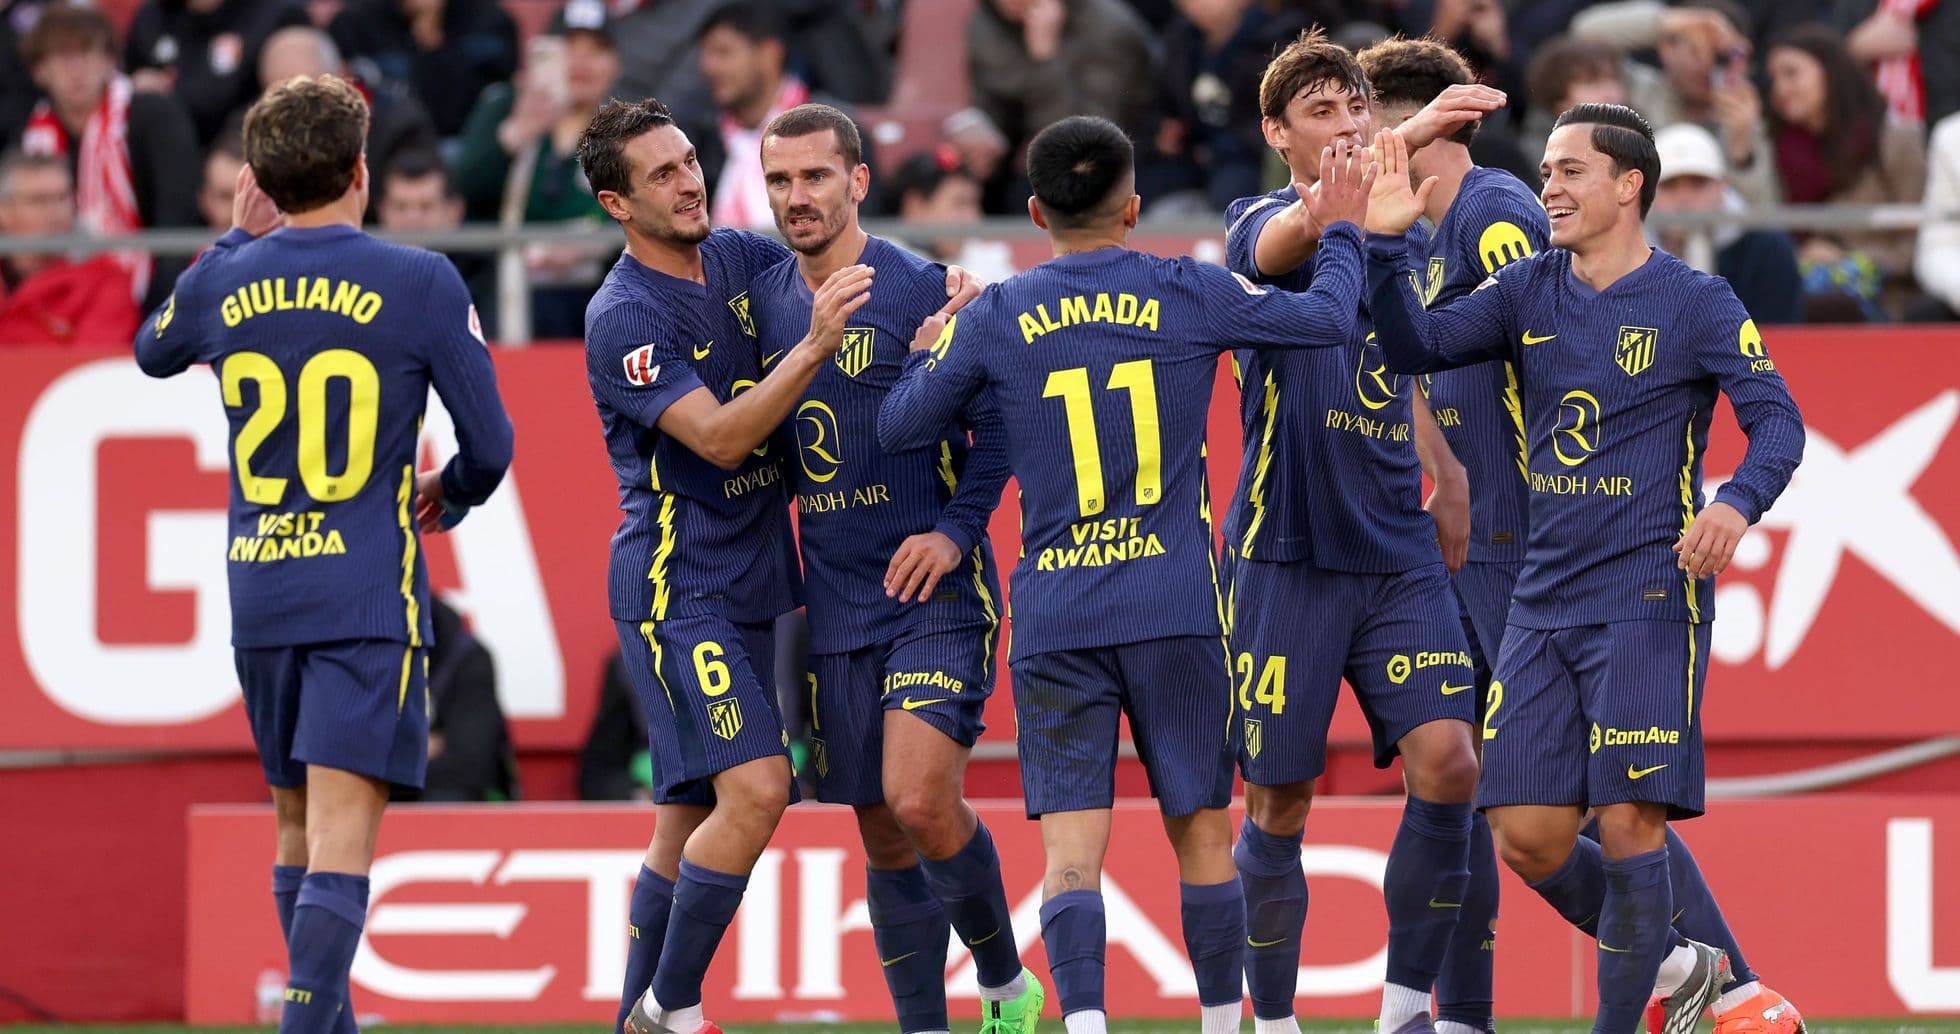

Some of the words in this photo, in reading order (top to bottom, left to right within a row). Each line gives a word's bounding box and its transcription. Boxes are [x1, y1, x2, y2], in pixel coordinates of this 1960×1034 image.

[220, 276, 383, 328] GIULIANO
[1017, 293, 1160, 345] ALMADA
[221, 348, 381, 506] 20
[1325, 409, 1385, 439] RIYADH
[1385, 423, 1409, 441] AIR
[1436, 408, 1461, 427] AIR
[1042, 359, 1162, 517] 11
[724, 463, 780, 499] RIYADH
[1530, 472, 1587, 495] RIYADH
[1592, 476, 1632, 496] AIR
[799, 490, 846, 513] IYADH
[852, 484, 890, 508] AIR
[257, 511, 326, 536] VISIT
[1071, 517, 1143, 545] VISIT
[229, 529, 347, 562] RWANDA
[1037, 533, 1166, 571] RWANDA
[692, 641, 731, 697] 6
[893, 671, 963, 694] ComAve
[1237, 652, 1286, 714] 24
[1605, 726, 1680, 745] ComAve
